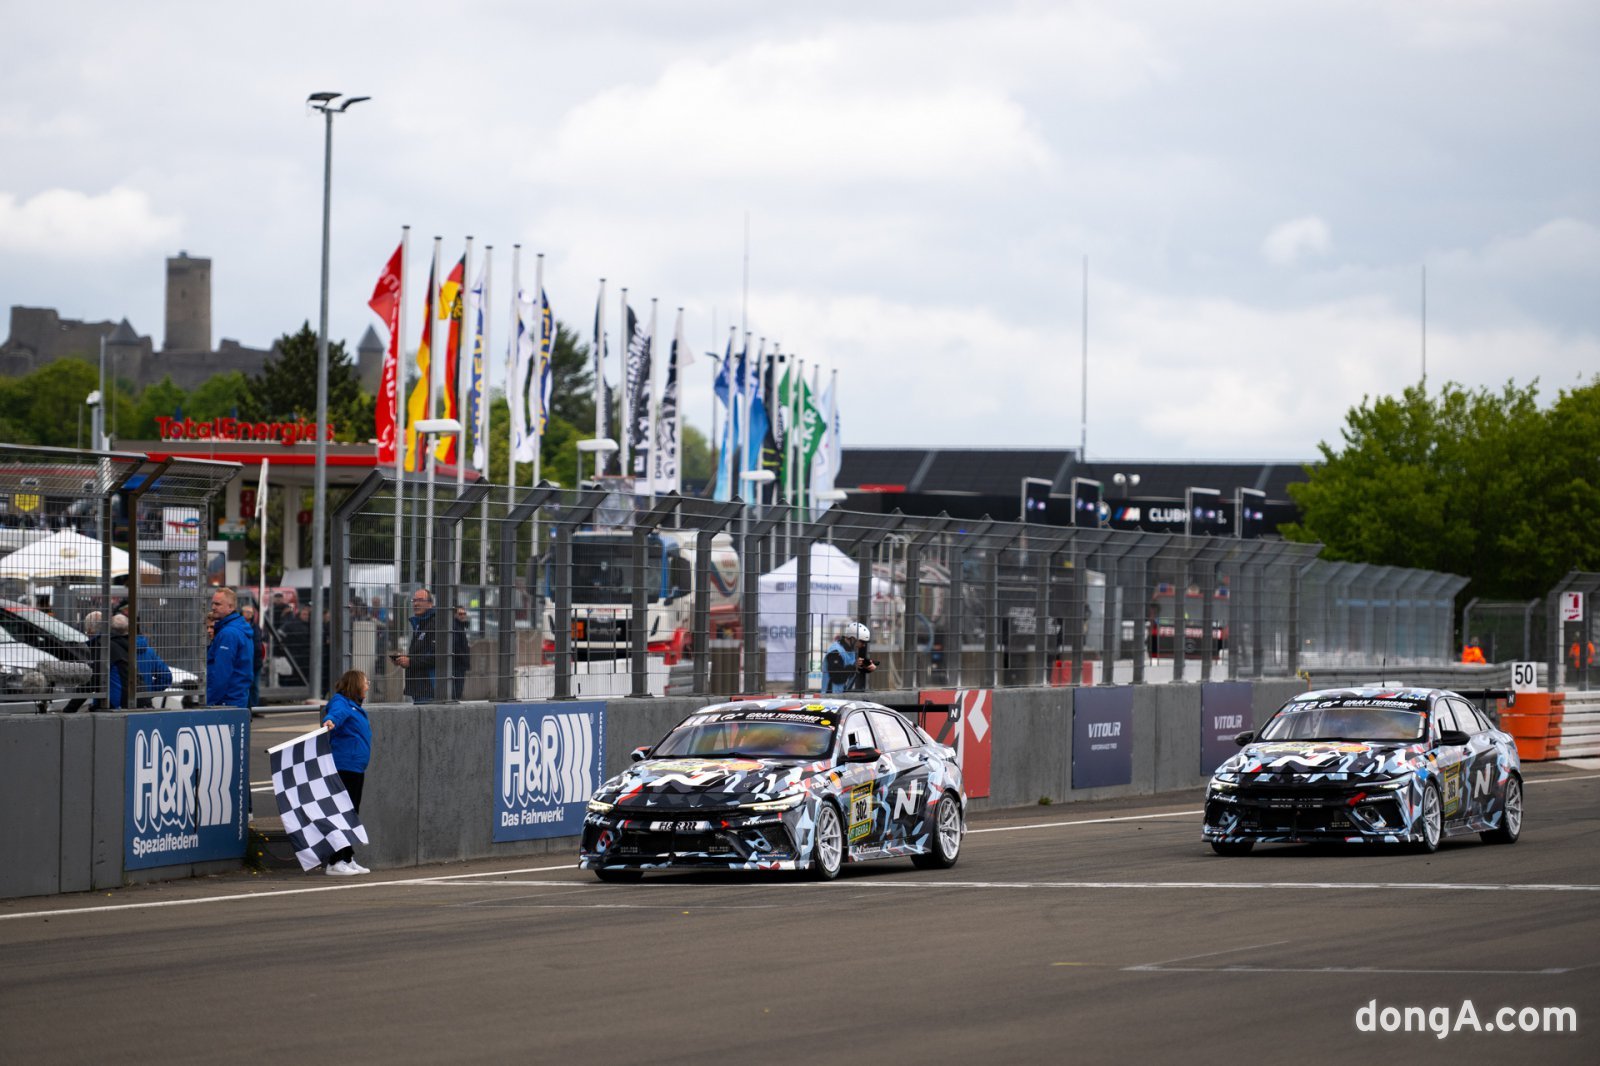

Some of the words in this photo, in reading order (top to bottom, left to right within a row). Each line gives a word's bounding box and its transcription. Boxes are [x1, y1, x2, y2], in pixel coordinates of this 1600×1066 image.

[155, 416, 335, 446] TotalEnergies
[1515, 664, 1534, 685] 50
[776, 712, 821, 721] TURISMO
[502, 715, 563, 808] H&R
[134, 727, 200, 833] H&R
[1474, 762, 1491, 799] N
[855, 799, 867, 821] 302
[894, 779, 918, 820] N
[501, 811, 519, 827] Das
[521, 806, 564, 825] Fahrwerk!
[133, 832, 199, 858] Spezialfedern
